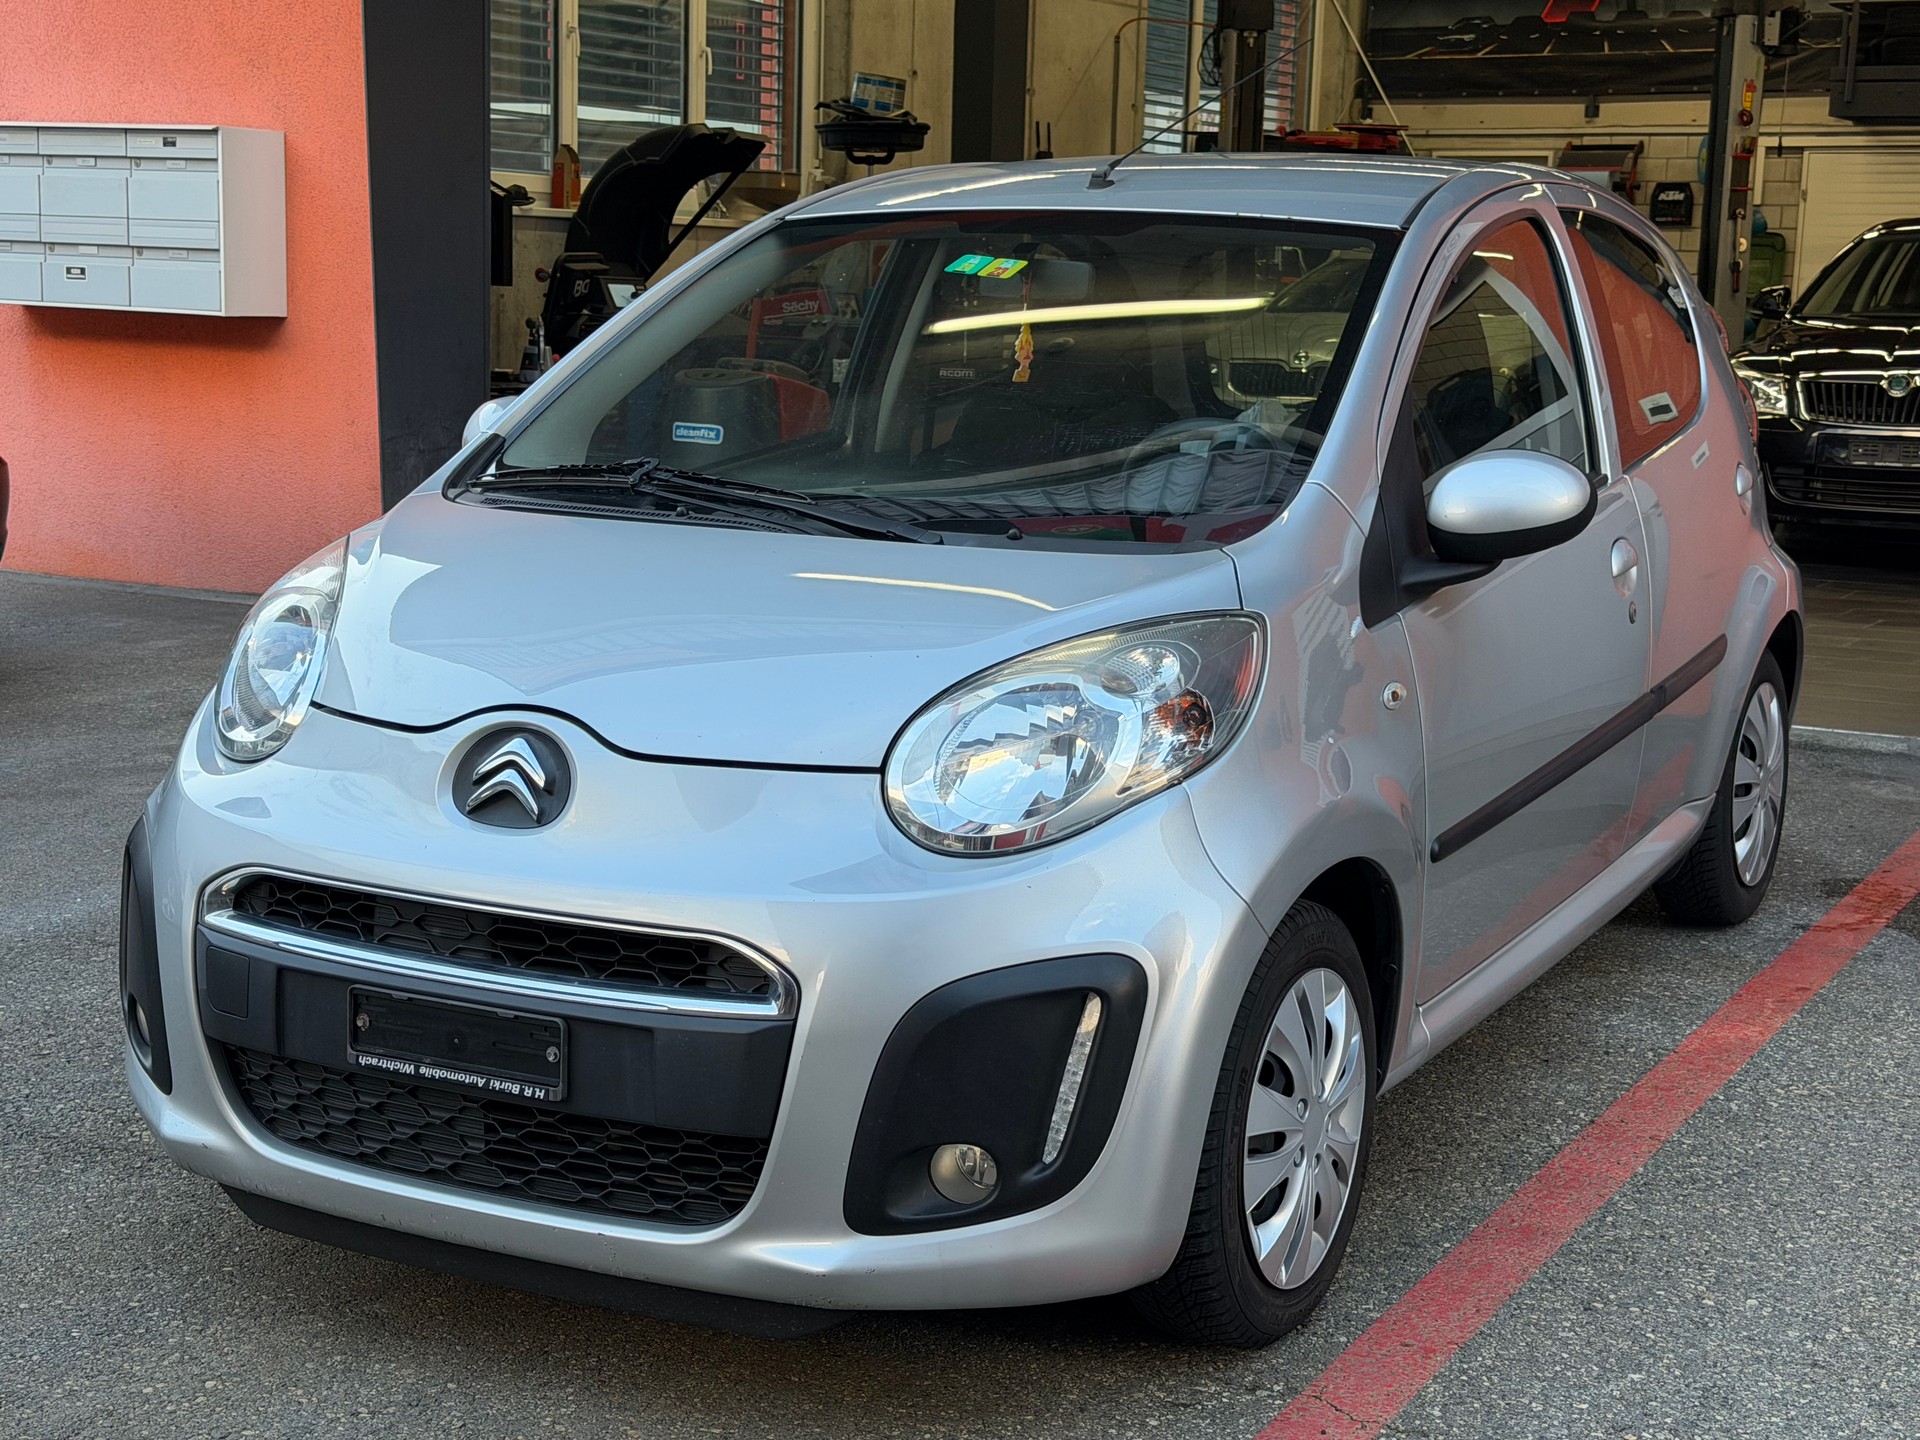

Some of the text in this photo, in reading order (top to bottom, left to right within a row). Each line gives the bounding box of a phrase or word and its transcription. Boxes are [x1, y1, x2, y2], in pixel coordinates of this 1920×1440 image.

[1657, 190, 1686, 200] KTM
[675, 427, 718, 439] cleanfix
[358, 1054, 415, 1075] Wichtrach
[418, 1065, 487, 1088] Automobile
